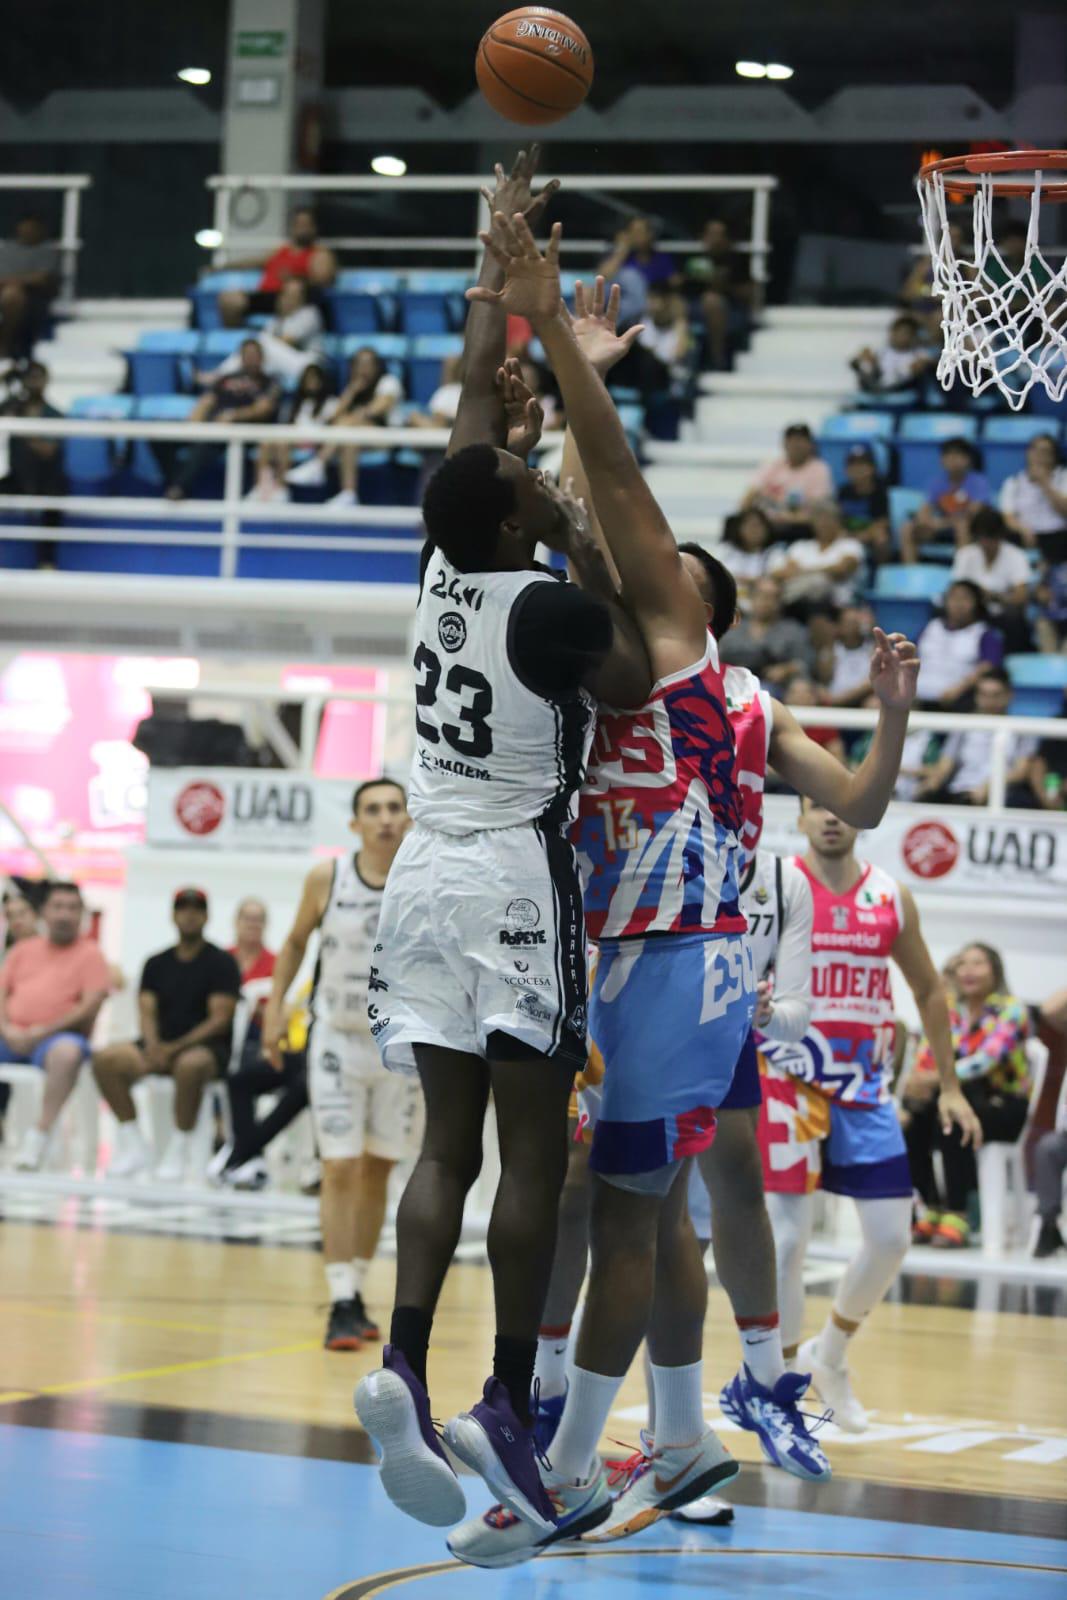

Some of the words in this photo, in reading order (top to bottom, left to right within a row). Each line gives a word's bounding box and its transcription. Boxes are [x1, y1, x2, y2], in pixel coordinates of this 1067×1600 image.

[413, 640, 493, 758] 23
[233, 781, 313, 823] UAD
[596, 798, 639, 853] 13
[967, 823, 1057, 871] UAD
[499, 930, 547, 945] POPEYE
[748, 913, 775, 937] 77
[812, 931, 881, 949] essential
[498, 976, 552, 987] SCOCESA
